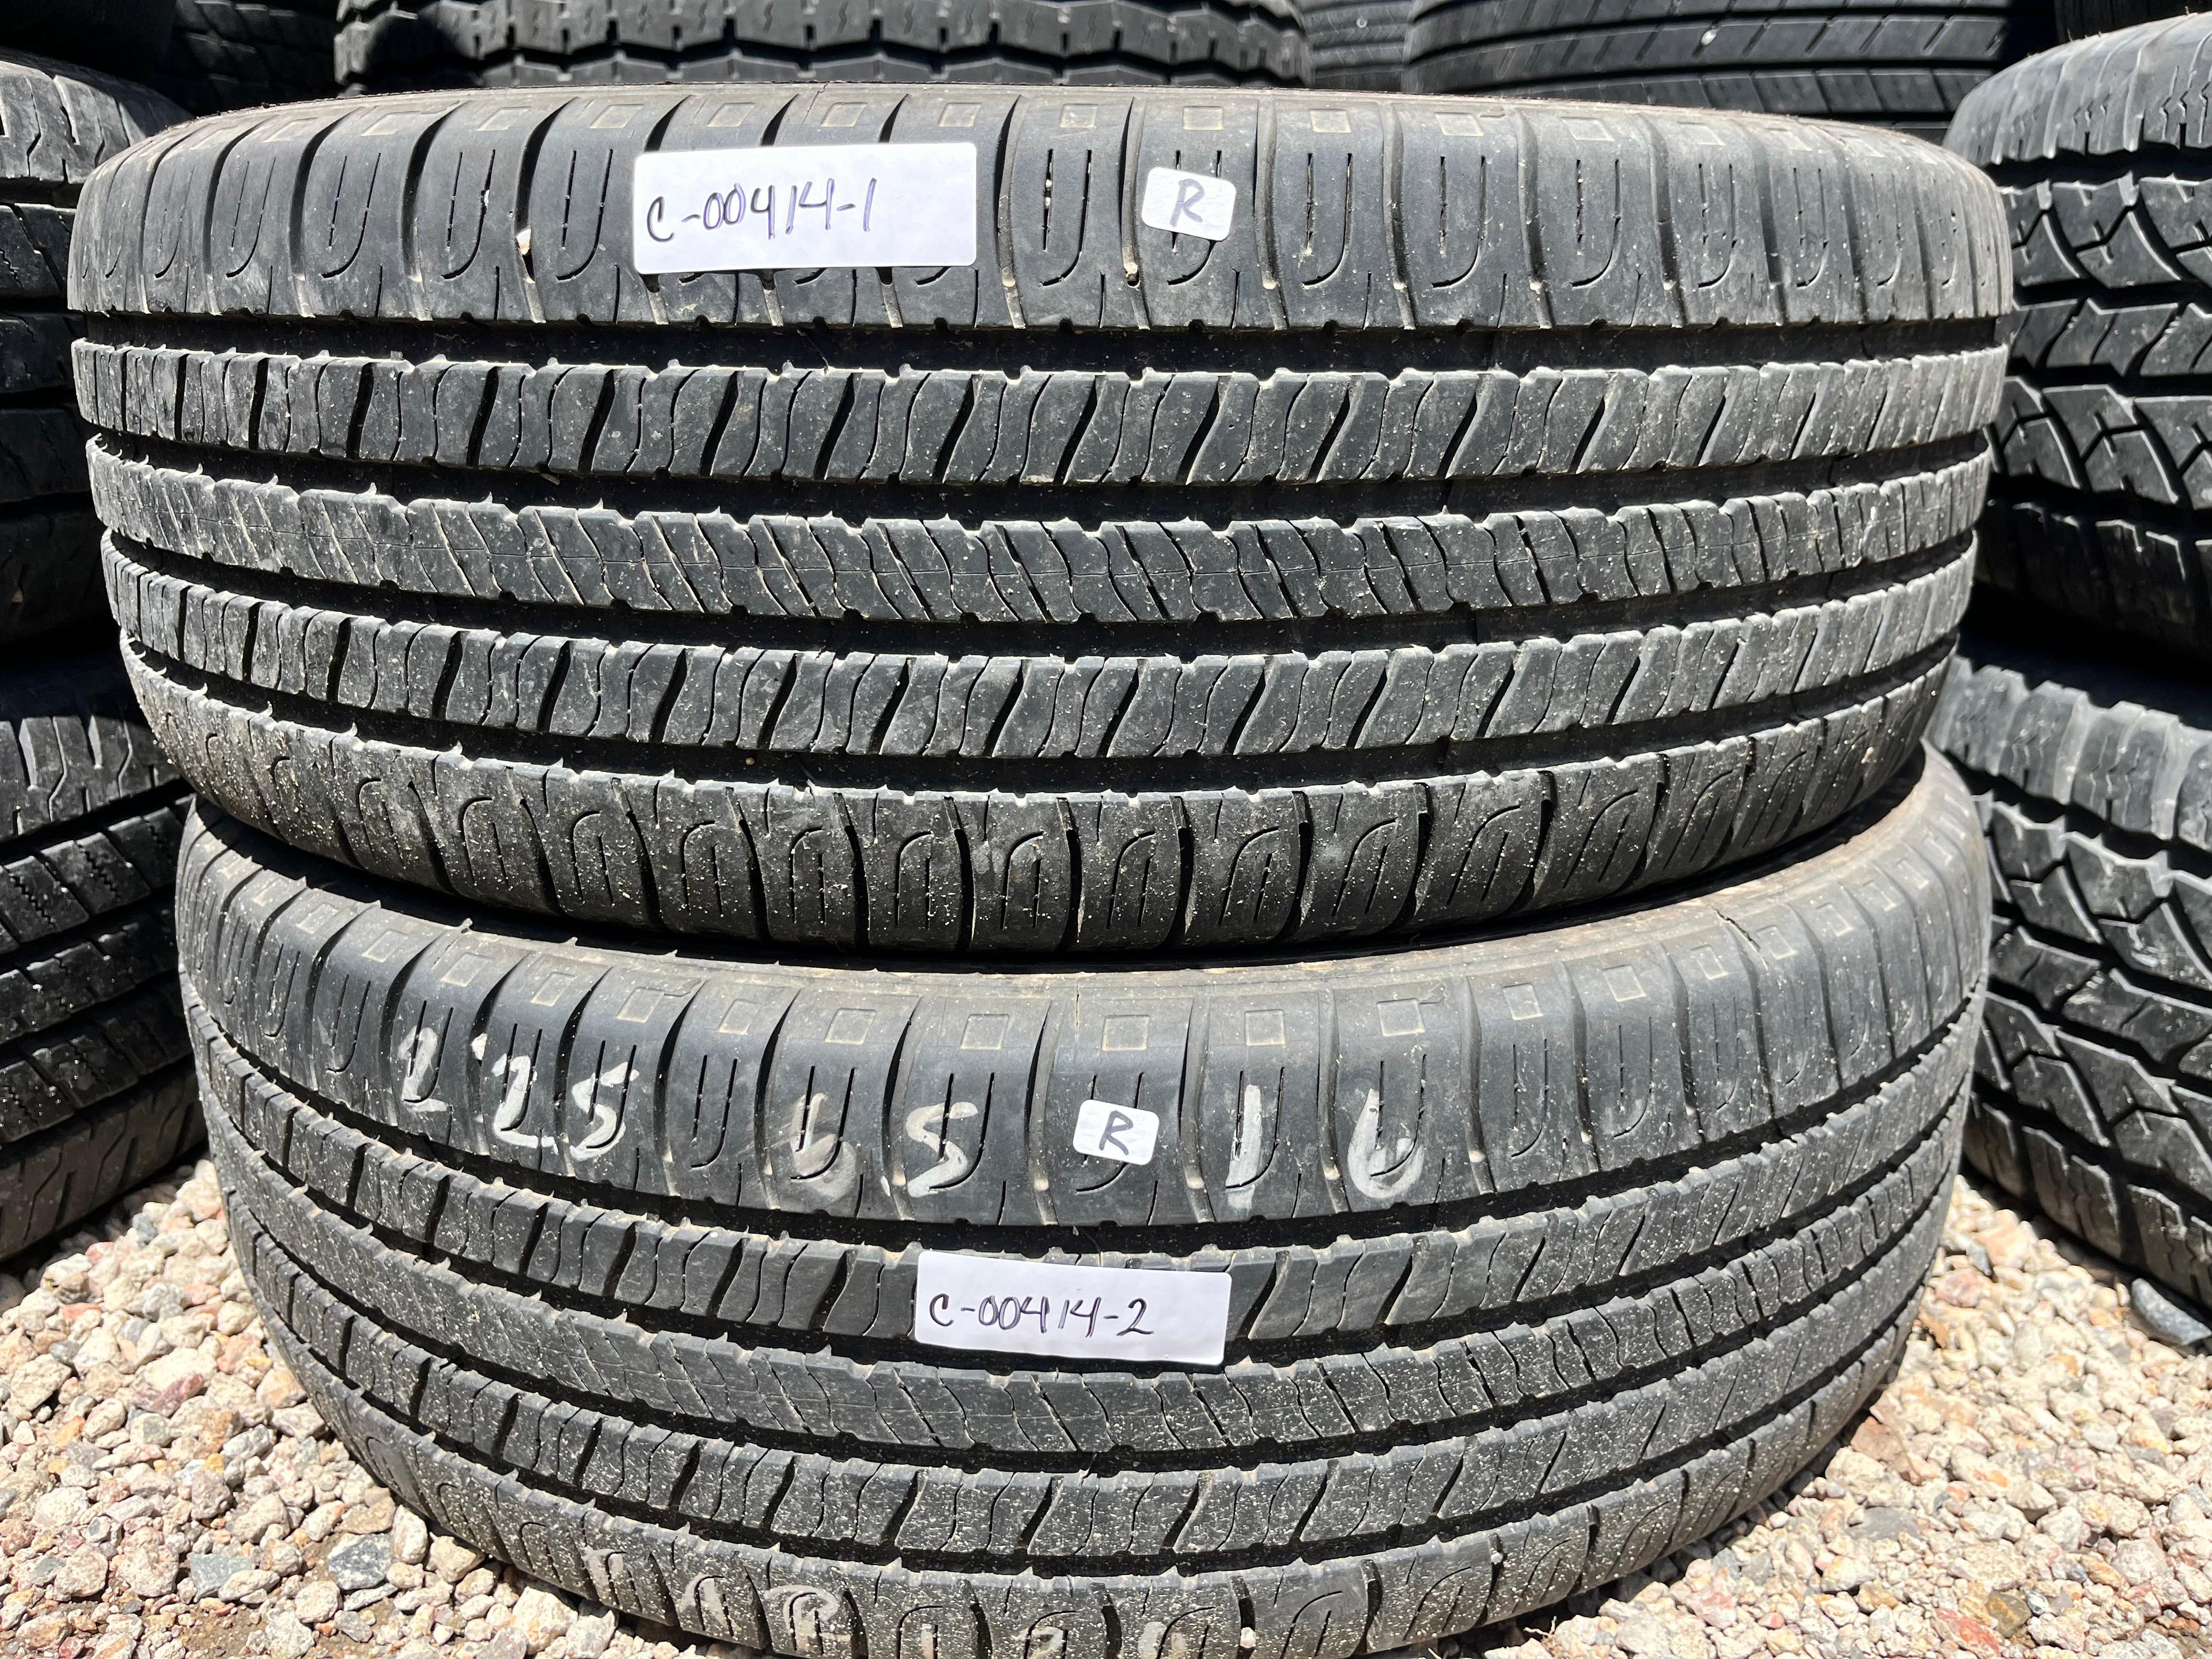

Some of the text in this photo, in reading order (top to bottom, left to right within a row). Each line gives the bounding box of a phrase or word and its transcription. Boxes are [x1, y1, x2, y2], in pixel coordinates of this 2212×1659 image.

[646, 177, 877, 243] C-00414-1
[1169, 179, 1205, 228] R
[1099, 1110, 1134, 1156] R
[929, 1293, 1154, 1338] C-00414-2
